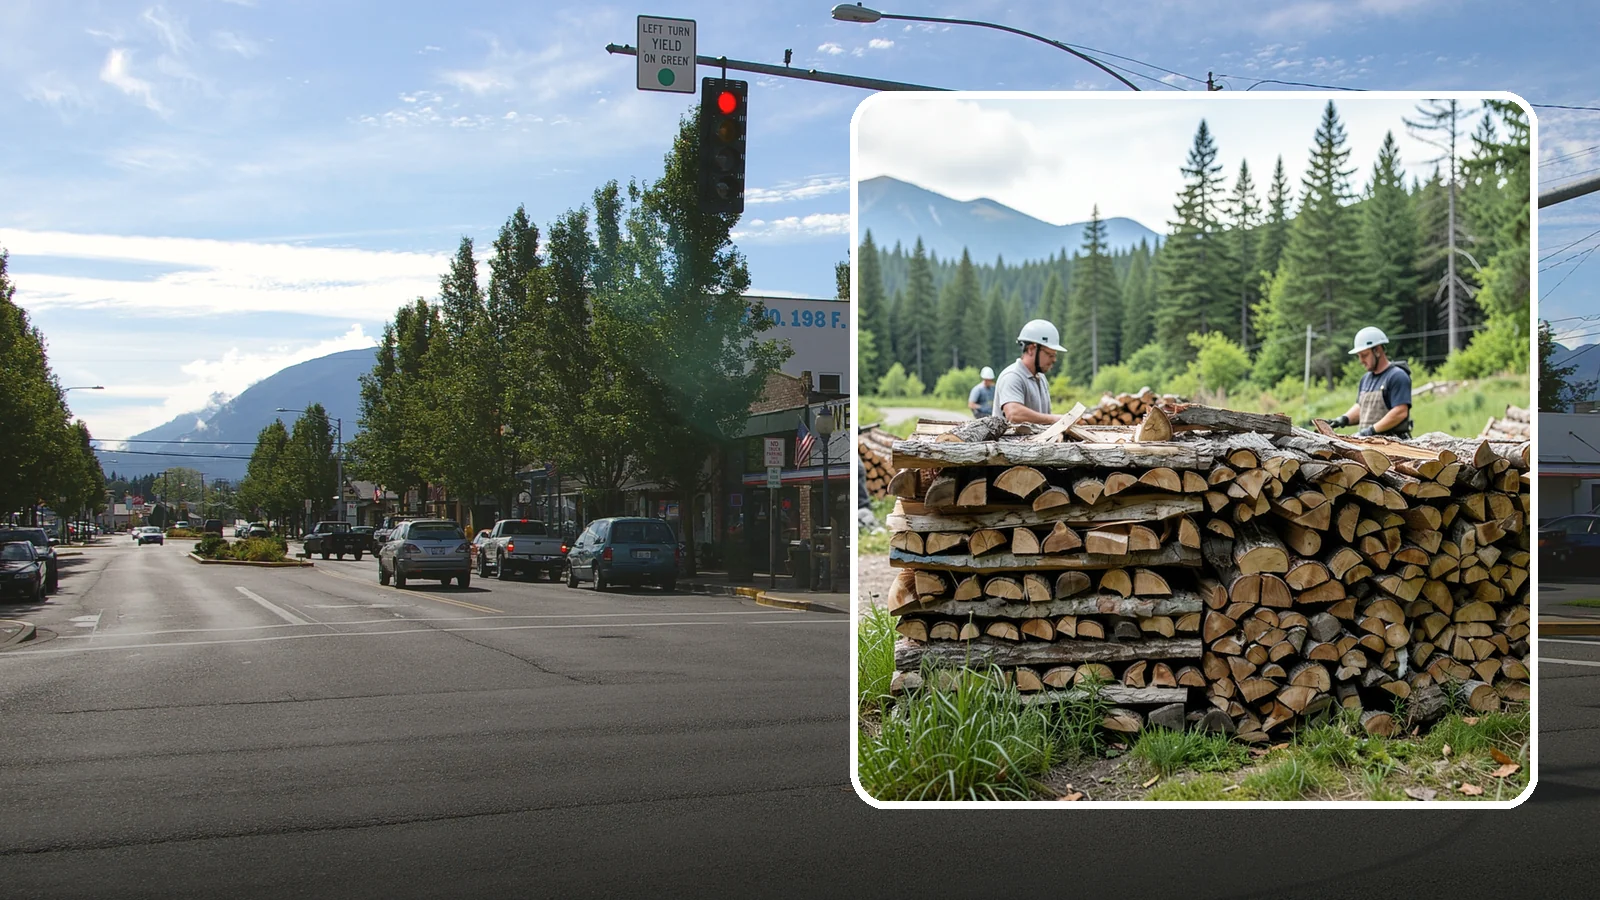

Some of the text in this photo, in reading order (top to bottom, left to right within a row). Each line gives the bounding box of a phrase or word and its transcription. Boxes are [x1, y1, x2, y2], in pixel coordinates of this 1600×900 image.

[642, 24, 690, 37] LEFT TURN
[652, 38, 682, 51] YIELD
[644, 54, 689, 66] ON GREEN
[791, 309, 826, 328] 198
[831, 311, 847, 329] F.
